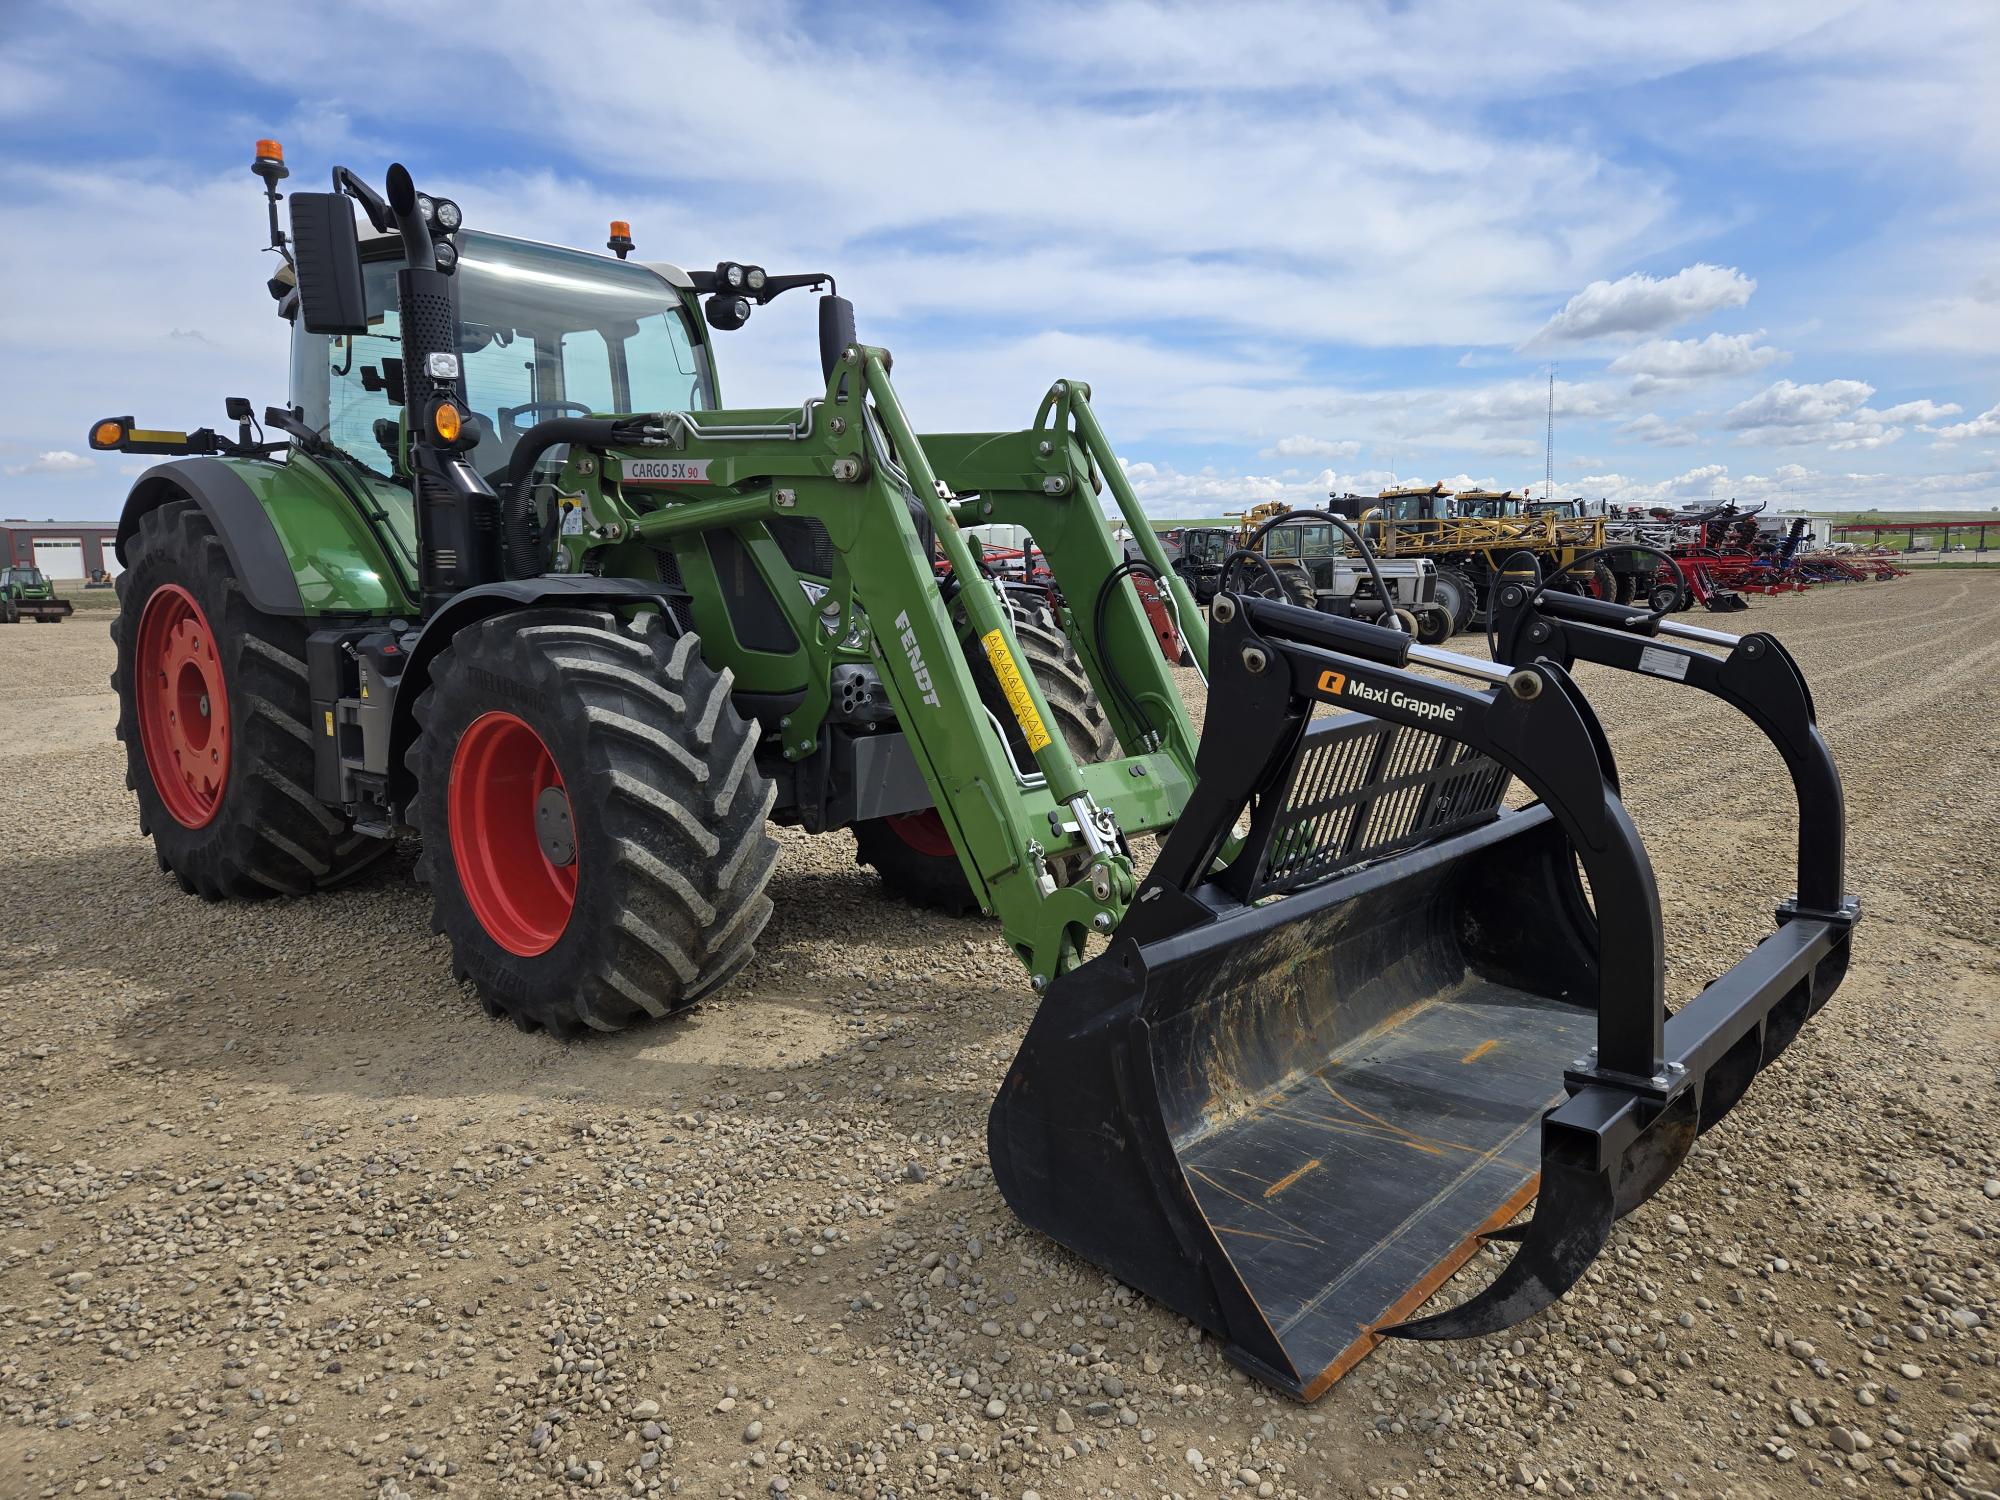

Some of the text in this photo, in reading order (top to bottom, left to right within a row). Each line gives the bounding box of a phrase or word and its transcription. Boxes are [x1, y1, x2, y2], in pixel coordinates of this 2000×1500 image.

[632, 463, 698, 478] CARGO 5X 90
[894, 609, 941, 708] FENDT
[1348, 679, 1389, 704] Maxi
